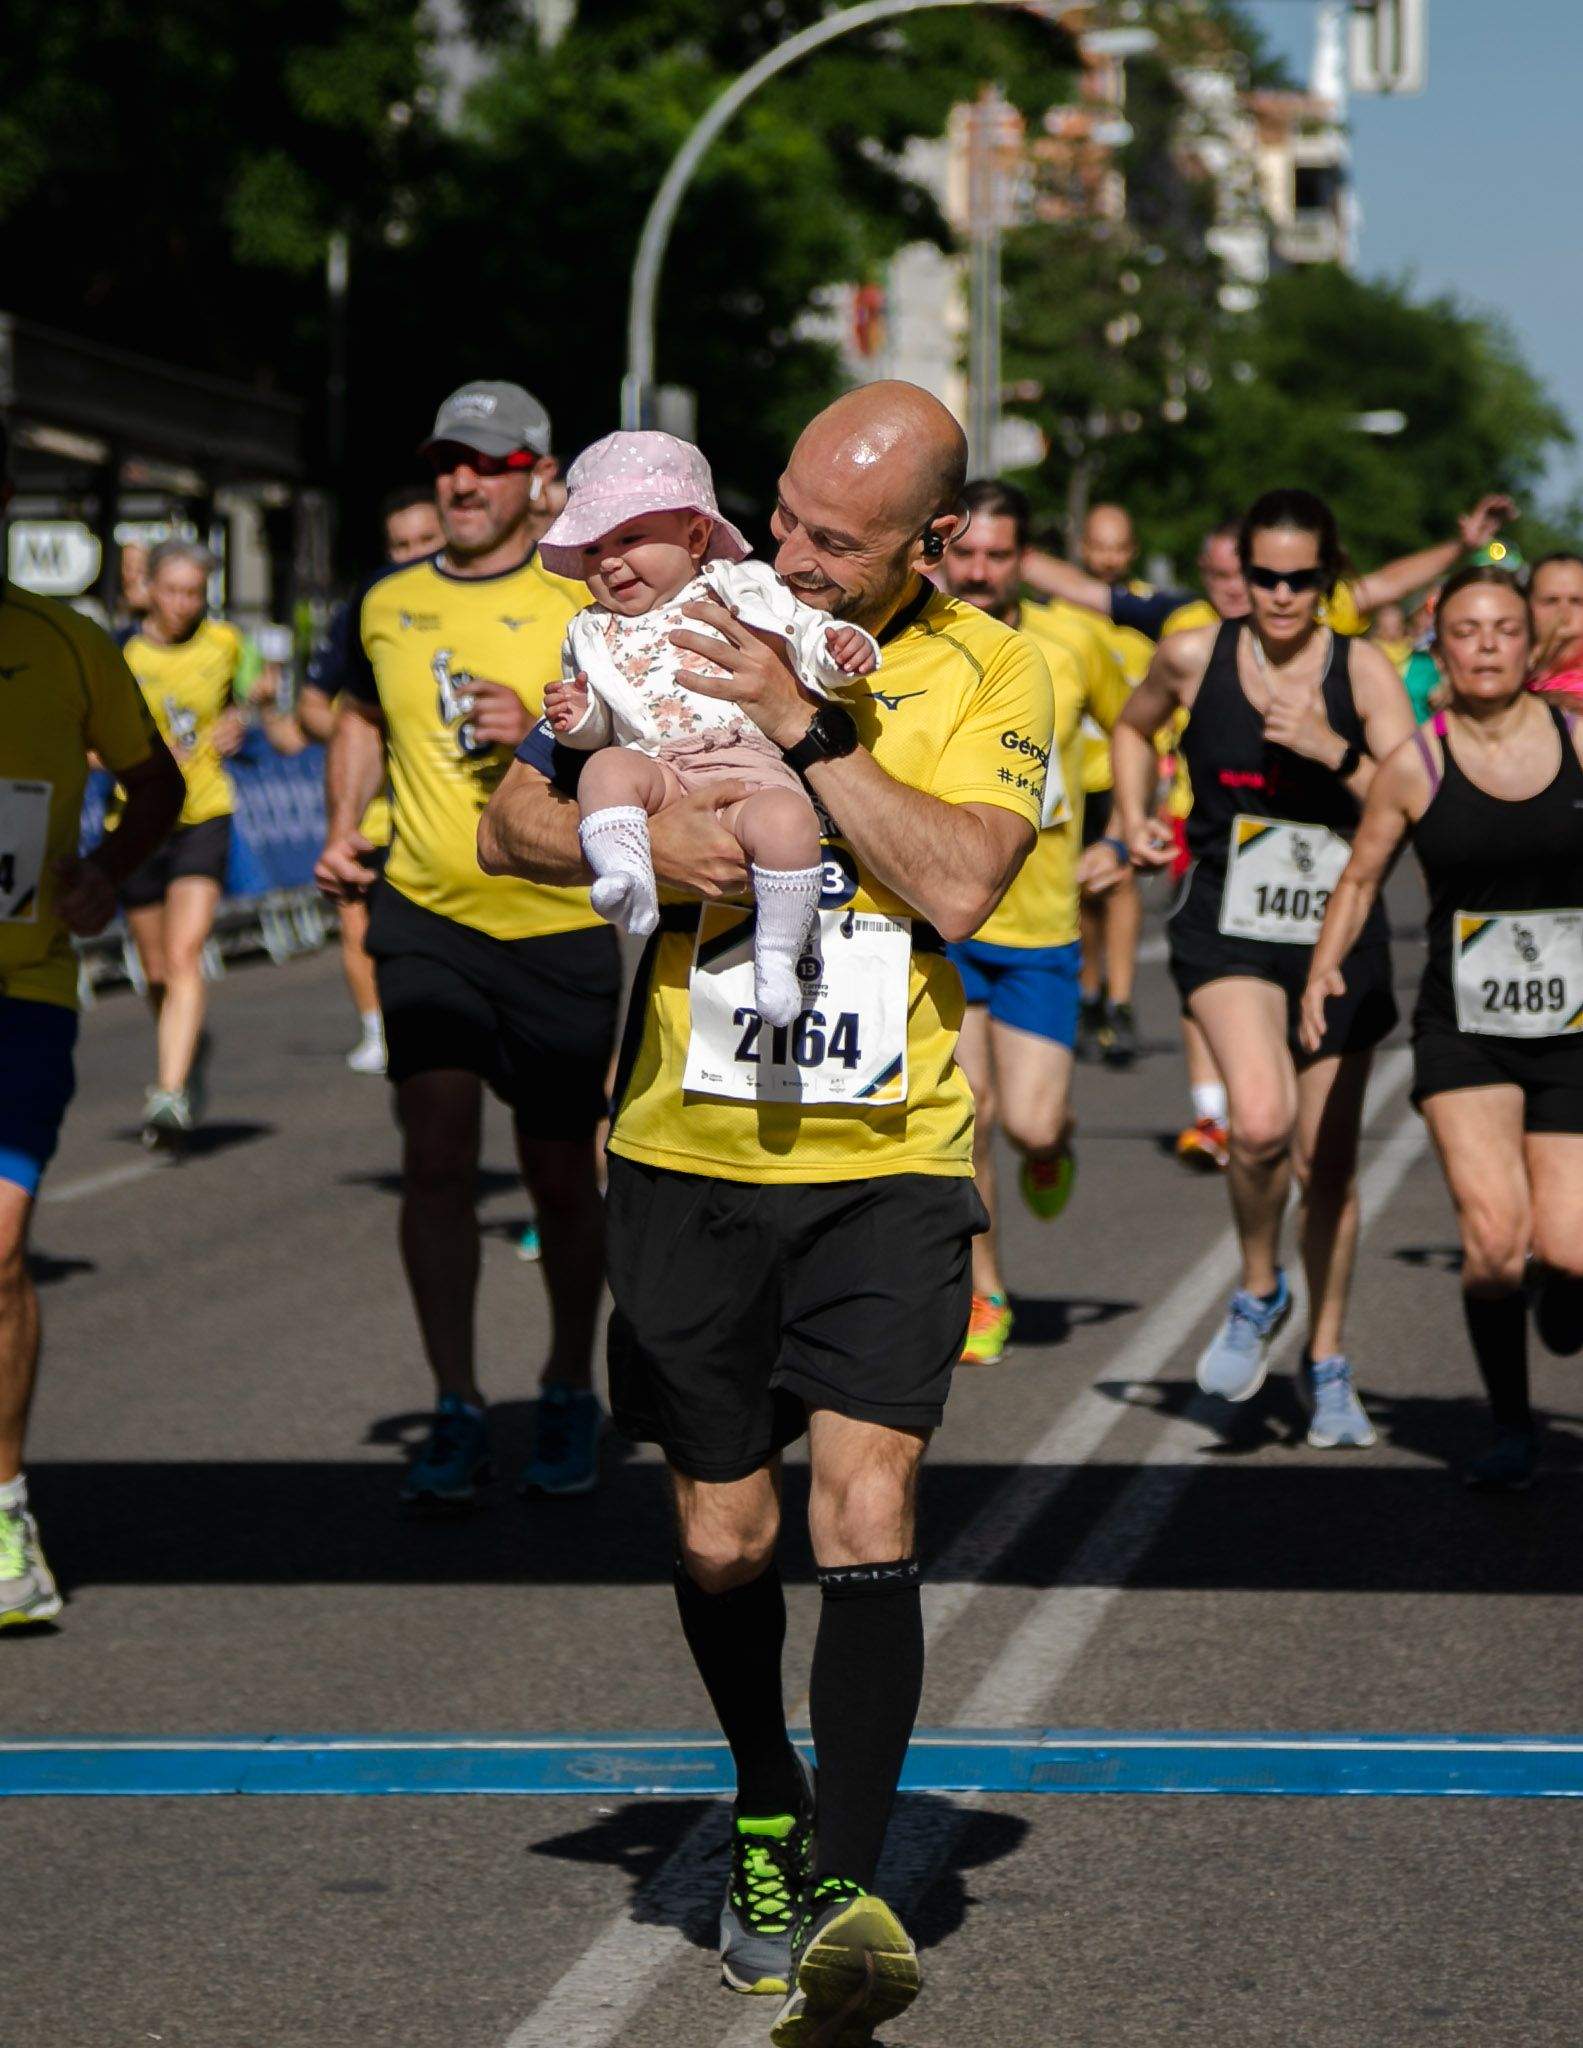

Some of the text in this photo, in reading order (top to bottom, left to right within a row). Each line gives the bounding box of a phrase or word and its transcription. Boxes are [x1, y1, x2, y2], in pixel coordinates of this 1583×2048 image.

[822, 861, 845, 894] 3
[1255, 884, 1331, 922] 1403
[1482, 977, 1566, 1014] 2489
[733, 1007, 861, 1069] 2164
